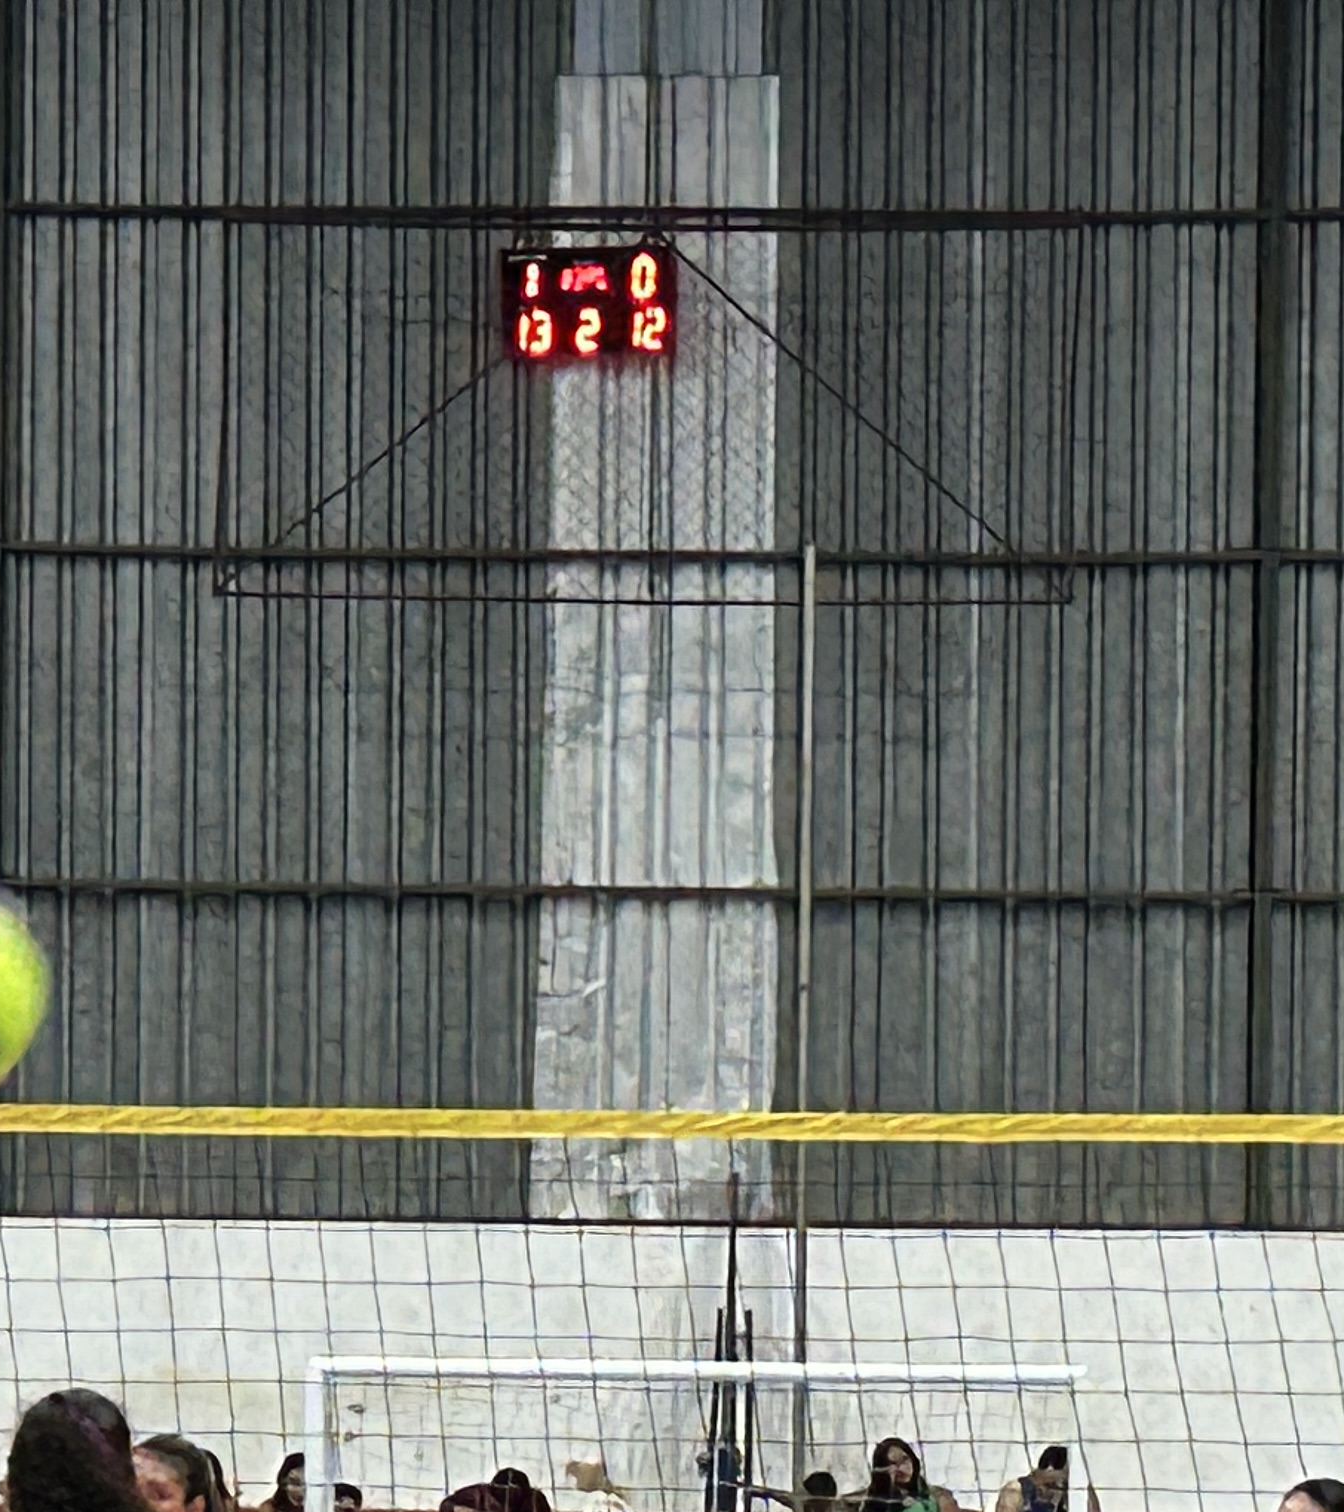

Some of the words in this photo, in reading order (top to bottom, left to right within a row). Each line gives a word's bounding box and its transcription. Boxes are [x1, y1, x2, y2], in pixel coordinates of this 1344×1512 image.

[630, 252, 657, 299] 0
[518, 308, 553, 354] 13
[574, 307, 602, 354] 2
[631, 306, 667, 350] 12
